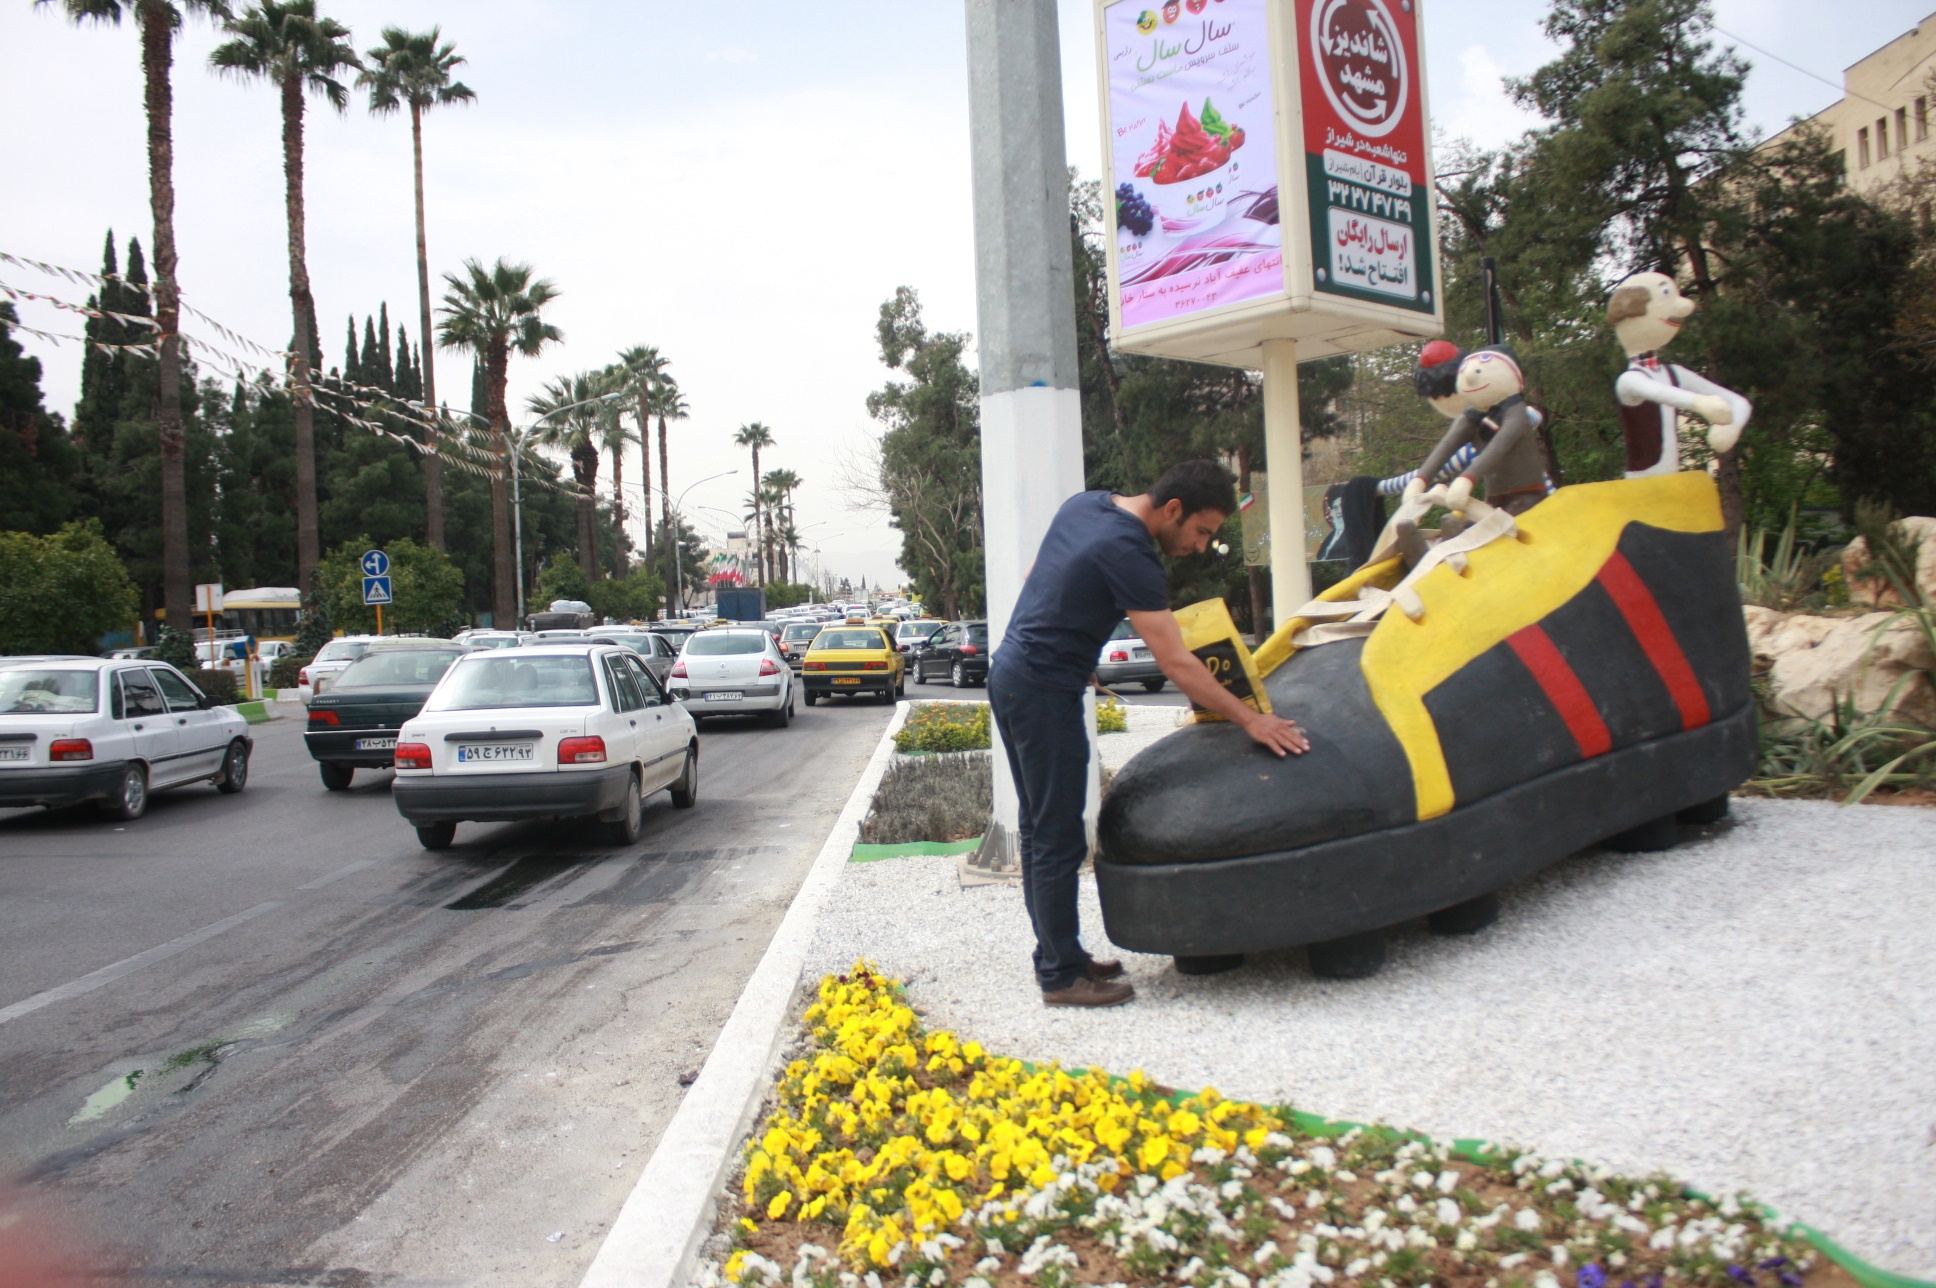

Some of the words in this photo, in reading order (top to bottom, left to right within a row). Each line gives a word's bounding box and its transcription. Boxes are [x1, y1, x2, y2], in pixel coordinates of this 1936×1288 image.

[1333, 25, 1388, 64] شاندیز
[1340, 63, 1386, 96] مشهد
[1326, 126, 1354, 148] شیراز
[1354, 138, 1367, 153] در
[1364, 164, 1387, 185] قرآن
[1388, 173, 1408, 193] بلوار
[1337, 219, 1374, 253] رایگان
[1374, 228, 1408, 260] ارسال
[1205, 267, 1221, 285] آباد
[1338, 253, 1367, 276] شد!
[1368, 260, 1408, 285] افتتاح
